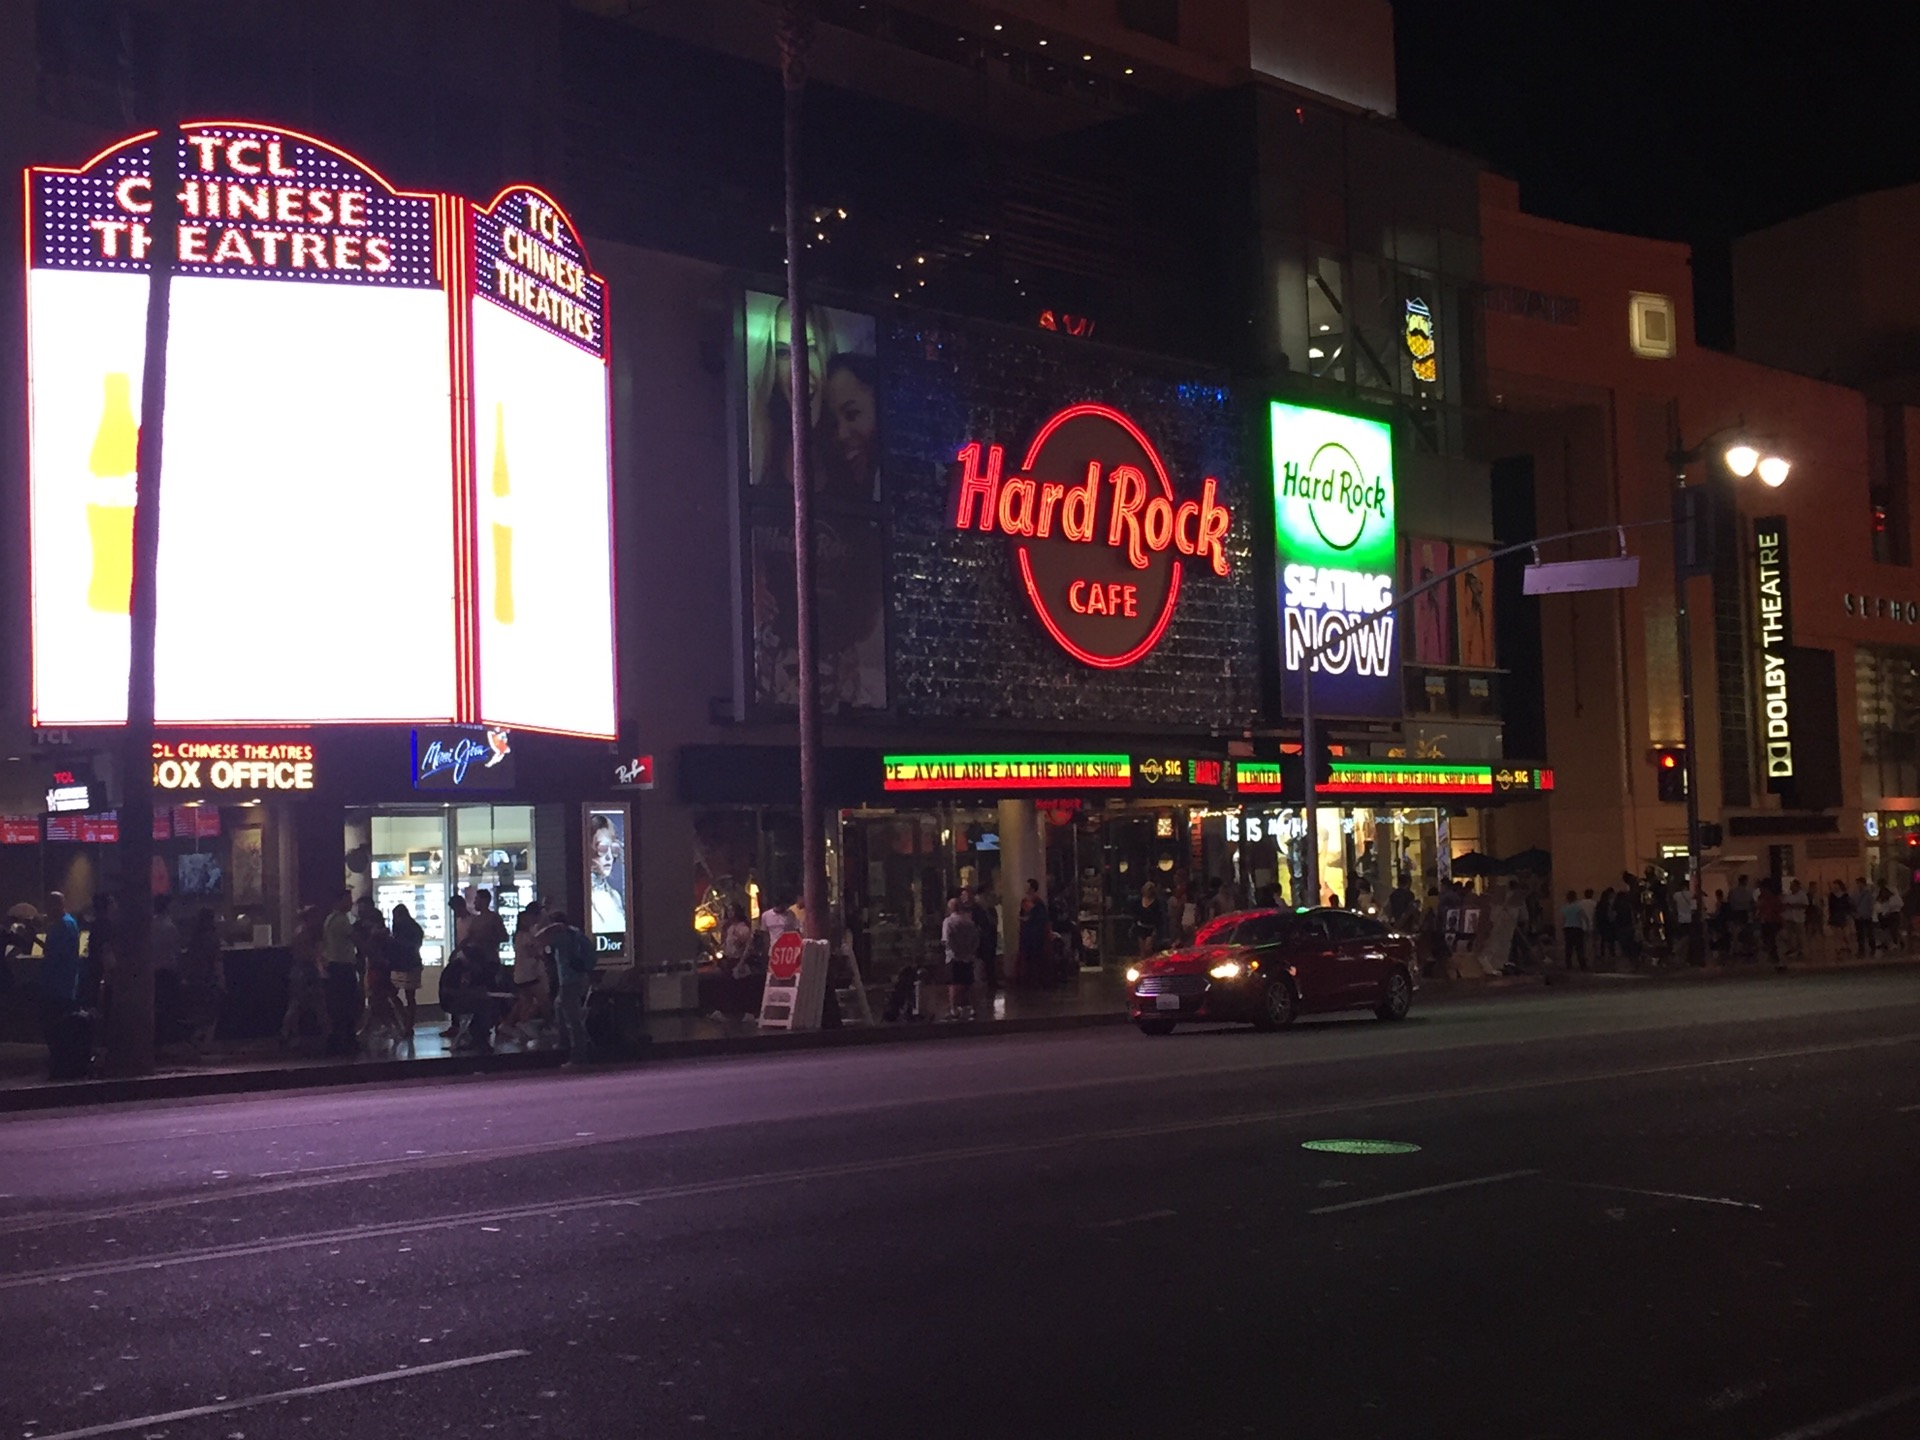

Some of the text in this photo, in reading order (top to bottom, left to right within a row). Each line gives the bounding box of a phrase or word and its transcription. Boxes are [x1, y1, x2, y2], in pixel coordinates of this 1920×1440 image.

[187, 134, 296, 178] TCL
[525, 195, 565, 249] TCL
[502, 224, 587, 301] CHINESE
[495, 257, 595, 342] THEATRES
[957, 443, 1230, 577] Hard Rock
[1283, 461, 1386, 518] Hard Rock
[1068, 580, 1138, 618] CAFE
[1284, 563, 1393, 615] SEATING
[1284, 607, 1394, 677] NOW
[1757, 532, 1789, 738] DOLBY THEATRE
[178, 743, 239, 759] CHINESE
[242, 744, 313, 760] THEATRES
[210, 760, 313, 789] OFFICE
[914, 763, 1000, 782] AVAILABLE
[1004, 762, 1022, 780] AT
[1027, 762, 1052, 780] THE
[1057, 762, 1090, 779] ROCK
[1092, 761, 1122, 780] SHOP
[595, 935, 622, 951] Dior
[772, 946, 801, 965] STOP
